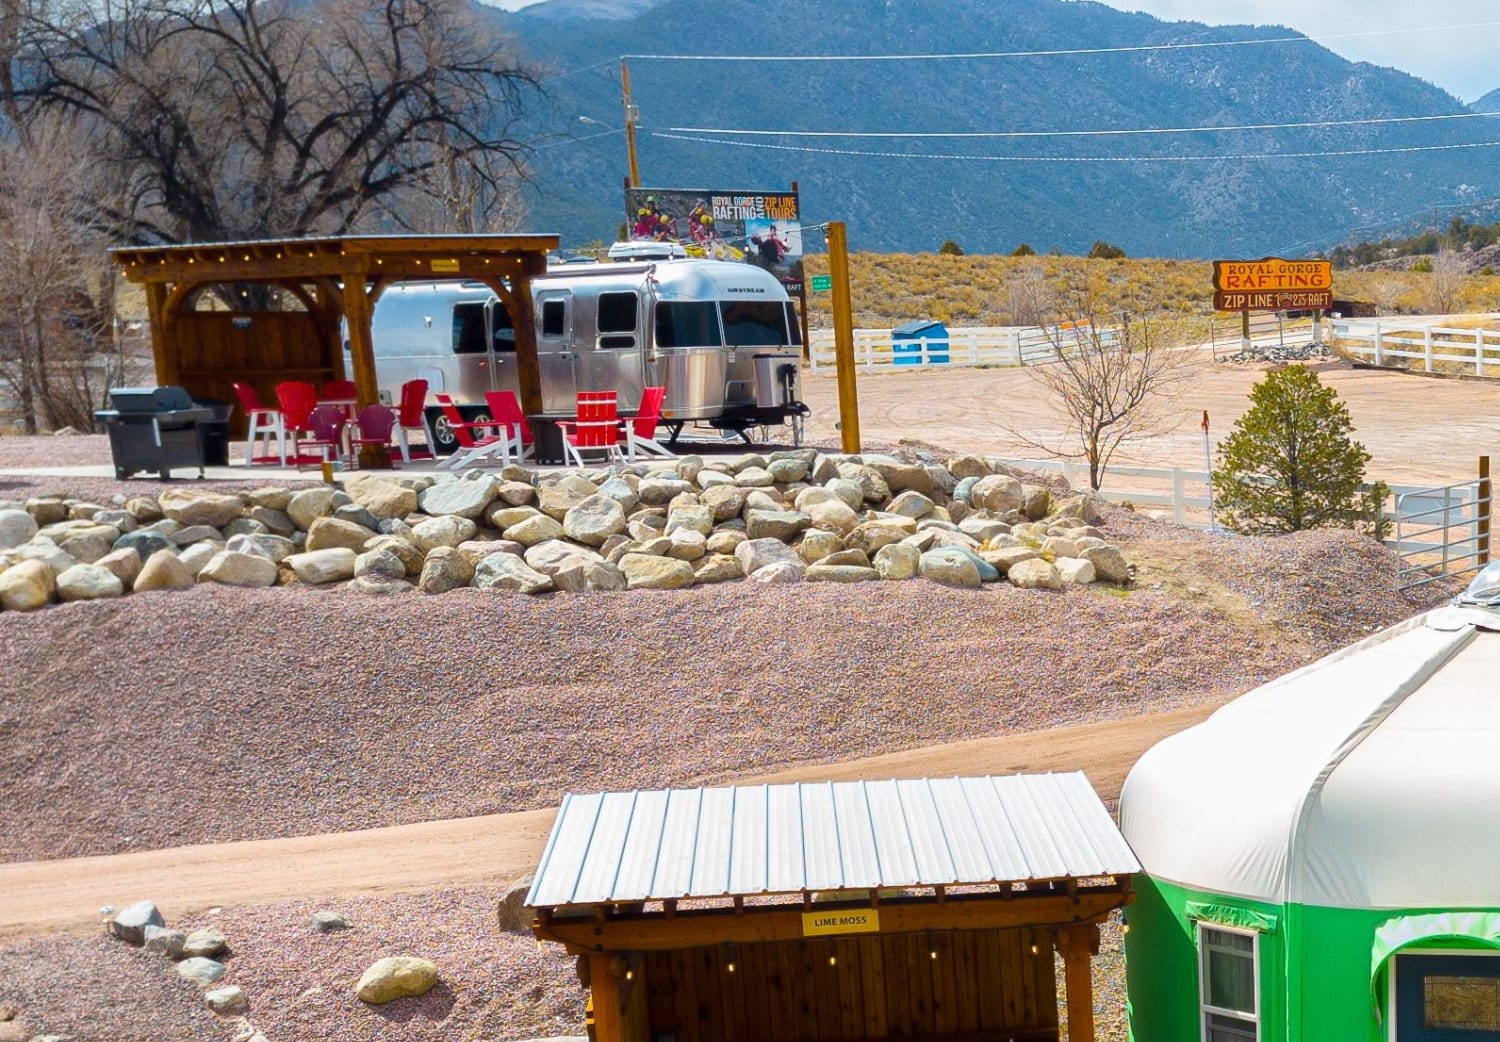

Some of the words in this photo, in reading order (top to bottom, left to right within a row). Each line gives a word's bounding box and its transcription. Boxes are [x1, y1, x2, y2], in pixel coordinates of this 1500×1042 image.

[712, 196, 732, 206] ROYAL
[756, 196, 764, 219] AND
[764, 197, 777, 208] ZIP
[779, 197, 796, 208] LINE
[713, 206, 756, 219] RAFTING
[767, 207, 796, 220] TOURS
[1229, 264, 1273, 274] ROYAL
[1279, 264, 1322, 273] GORGE
[1226, 275, 1323, 288] RAFTING
[1225, 295, 1245, 308] ZIP
[1248, 295, 1273, 307] LINE
[815, 918, 837, 927] LIME
[840, 916, 867, 925] MOSS
